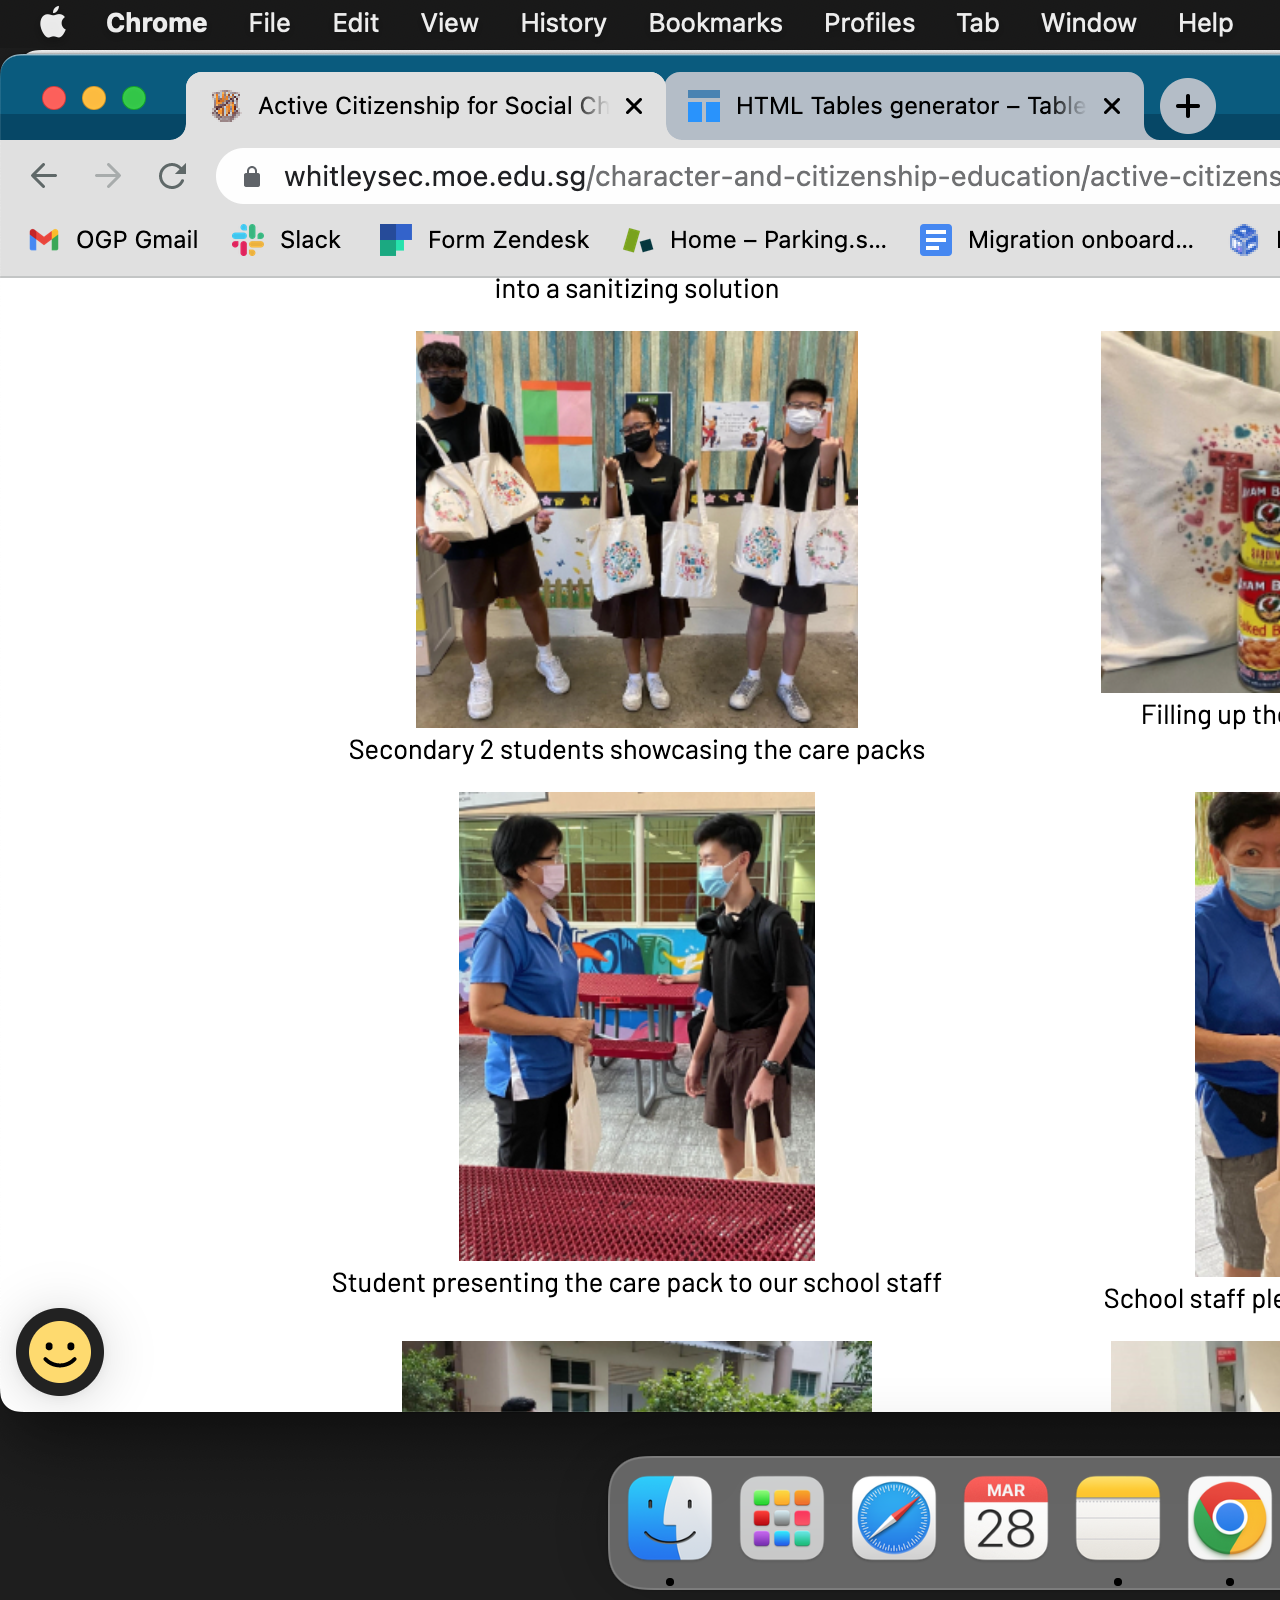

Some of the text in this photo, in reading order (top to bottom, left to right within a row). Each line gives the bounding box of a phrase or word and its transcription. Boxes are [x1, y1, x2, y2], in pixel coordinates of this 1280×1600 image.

[106, 11, 208, 34] Chrome
[249, 11, 291, 33] File
[333, 11, 380, 33] Edit
[420, 11, 480, 33] View
[521, 11, 608, 38] History
[649, 11, 783, 33] Bookmarks
[825, 11, 916, 33] Profiles
[956, 11, 1000, 33] Tab
[1040, 11, 1138, 33] Window
[1179, 11, 1234, 38] Help
[257, 95, 328, 116] Active
[335, 95, 460, 120] Citizenship
[466, 95, 499, 116] for
[504, 94, 572, 116] Social
[737, 95, 804, 115] HTML
[810, 95, 883, 116] Tables
[889, 96, 1000, 120] generator
[1027, 95, 1086, 116] Table
[76, 229, 198, 250] OGP Gmail
[280, 229, 342, 250] Slack
[429, 229, 590, 249] Form Zendesk
[671, 230, 737, 249] Home
[765, 229, 887, 254] Parking.s...
[969, 229, 1194, 254] Migration onboard...
[495, 278, 779, 305] into a sanitizing solution
[1142, 703, 1211, 731] Filling
[1218, 708, 1246, 731] up
[349, 738, 925, 766] Secondary 2 students showcasing the care packs
[332, 1271, 942, 1299] Student presenting the care pack to our school staff
[1104, 1287, 1183, 1309] School
[1190, 1287, 1246, 1309] staff
[987, 1483, 1026, 1497] MAR
[977, 1508, 1035, 1549] 28
